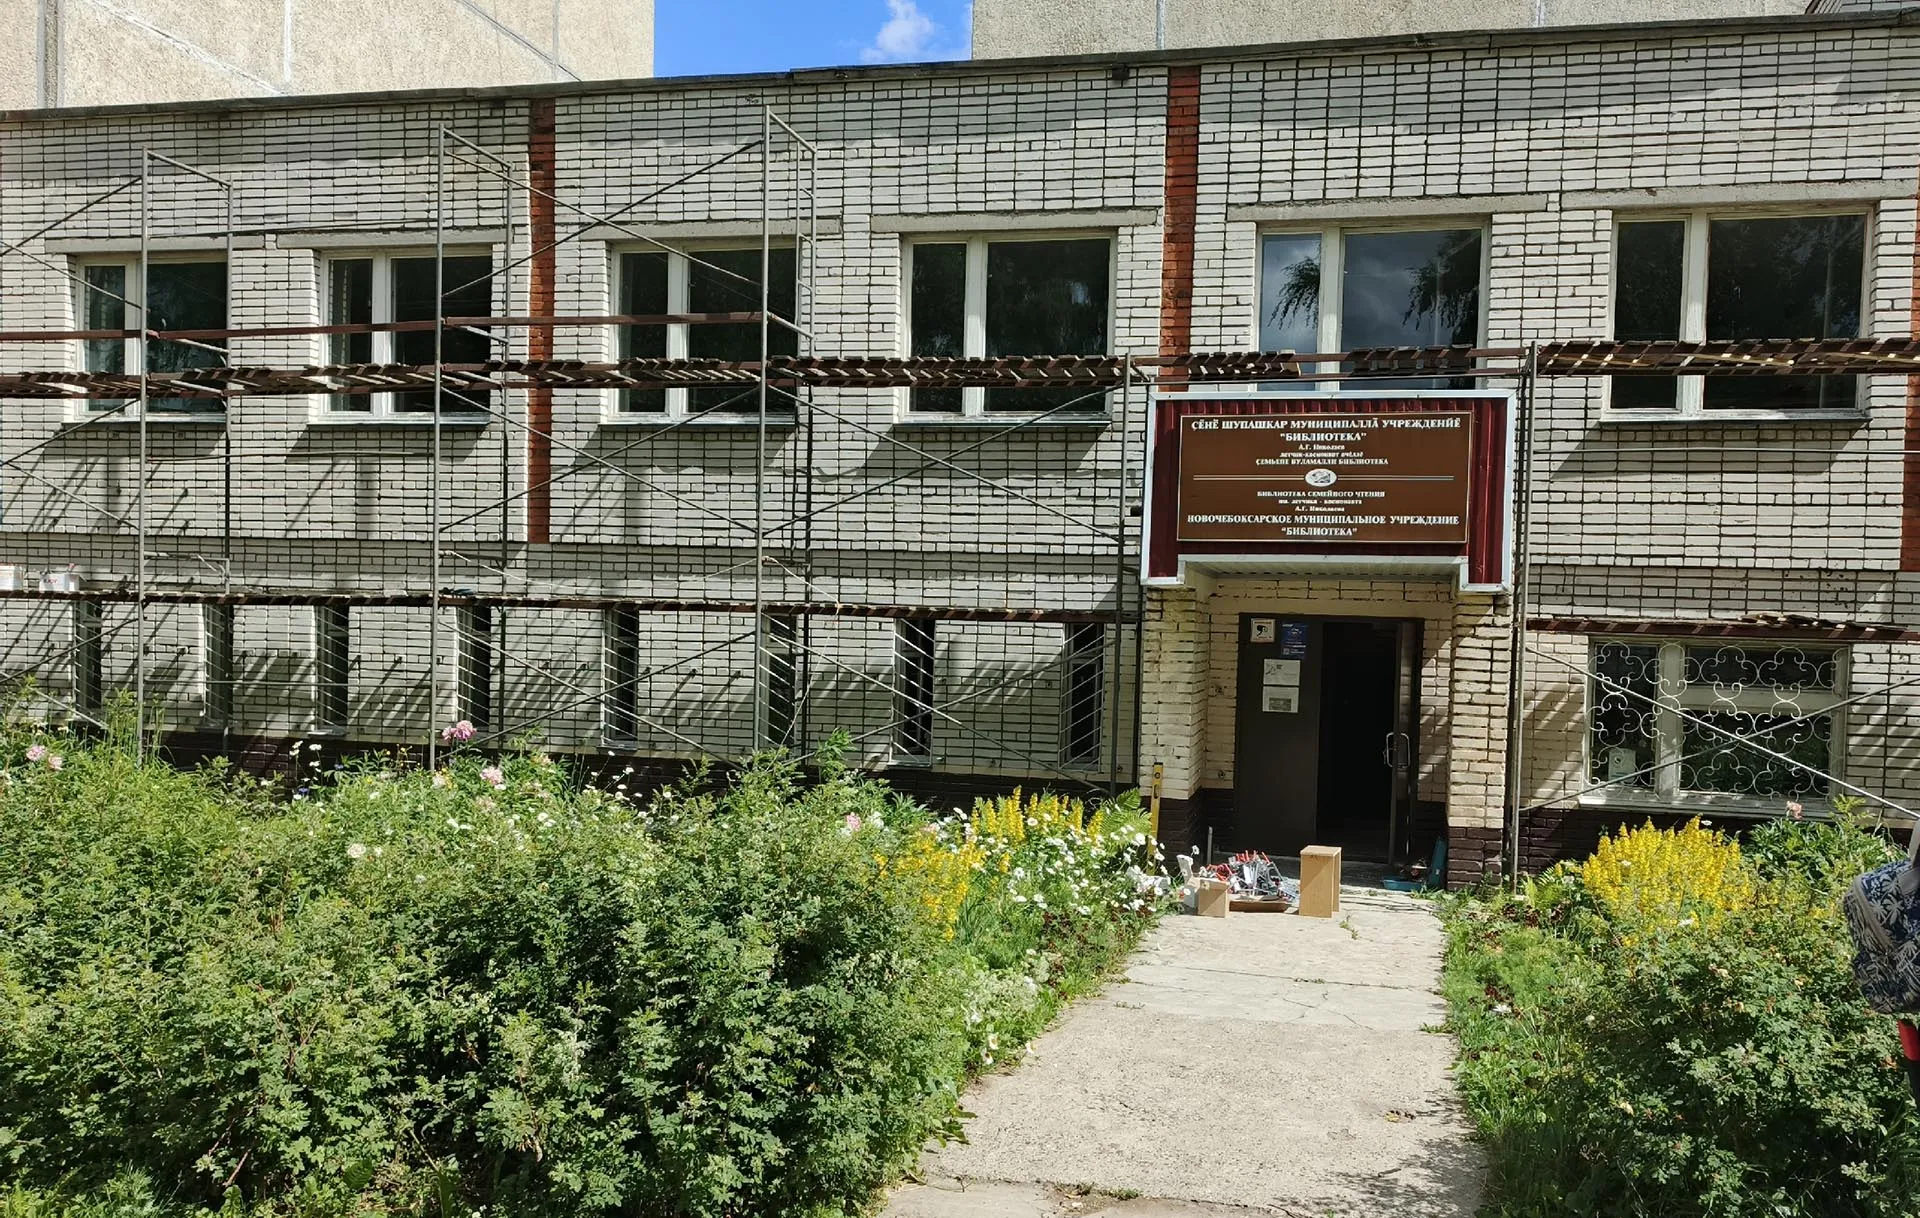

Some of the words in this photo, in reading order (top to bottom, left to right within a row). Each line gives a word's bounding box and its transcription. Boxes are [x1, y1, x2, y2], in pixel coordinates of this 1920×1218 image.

[1222, 420, 1288, 430] ШУПАШКАР
[1187, 514, 1292, 524] НОВОЧЕБОКСАРСКОЕ
[1294, 515, 1386, 525] МУНИЦИПАЛЬНОЕ
[1390, 515, 1460, 525] УЧРЕЖДЕНИЕ
